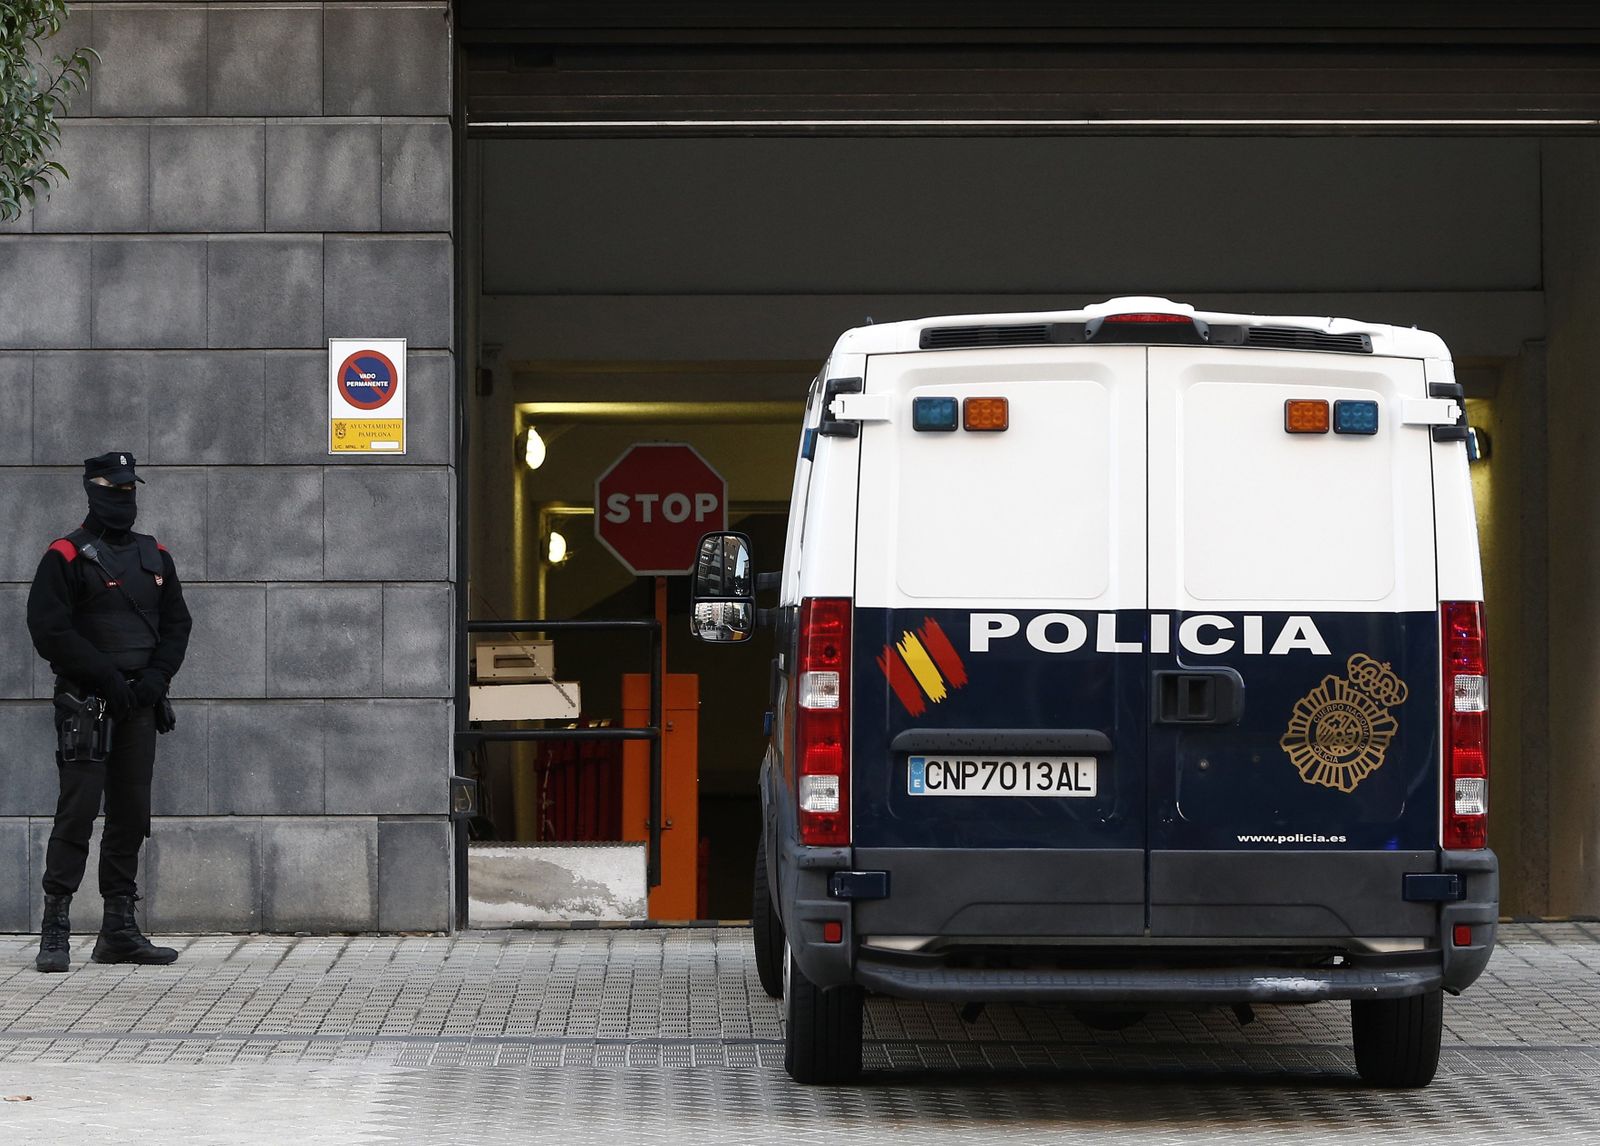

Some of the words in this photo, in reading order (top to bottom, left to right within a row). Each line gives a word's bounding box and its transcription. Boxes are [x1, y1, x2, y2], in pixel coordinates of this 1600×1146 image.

[604, 492, 718, 524] STOP
[969, 612, 1332, 655] POLICIA
[1313, 704, 1344, 724] CUERPO
[1312, 742, 1339, 763] POLICIA
[913, 778, 921, 788] E
[925, 760, 1092, 792] CNP7013AL
[1237, 833, 1347, 844] www.policia.es
